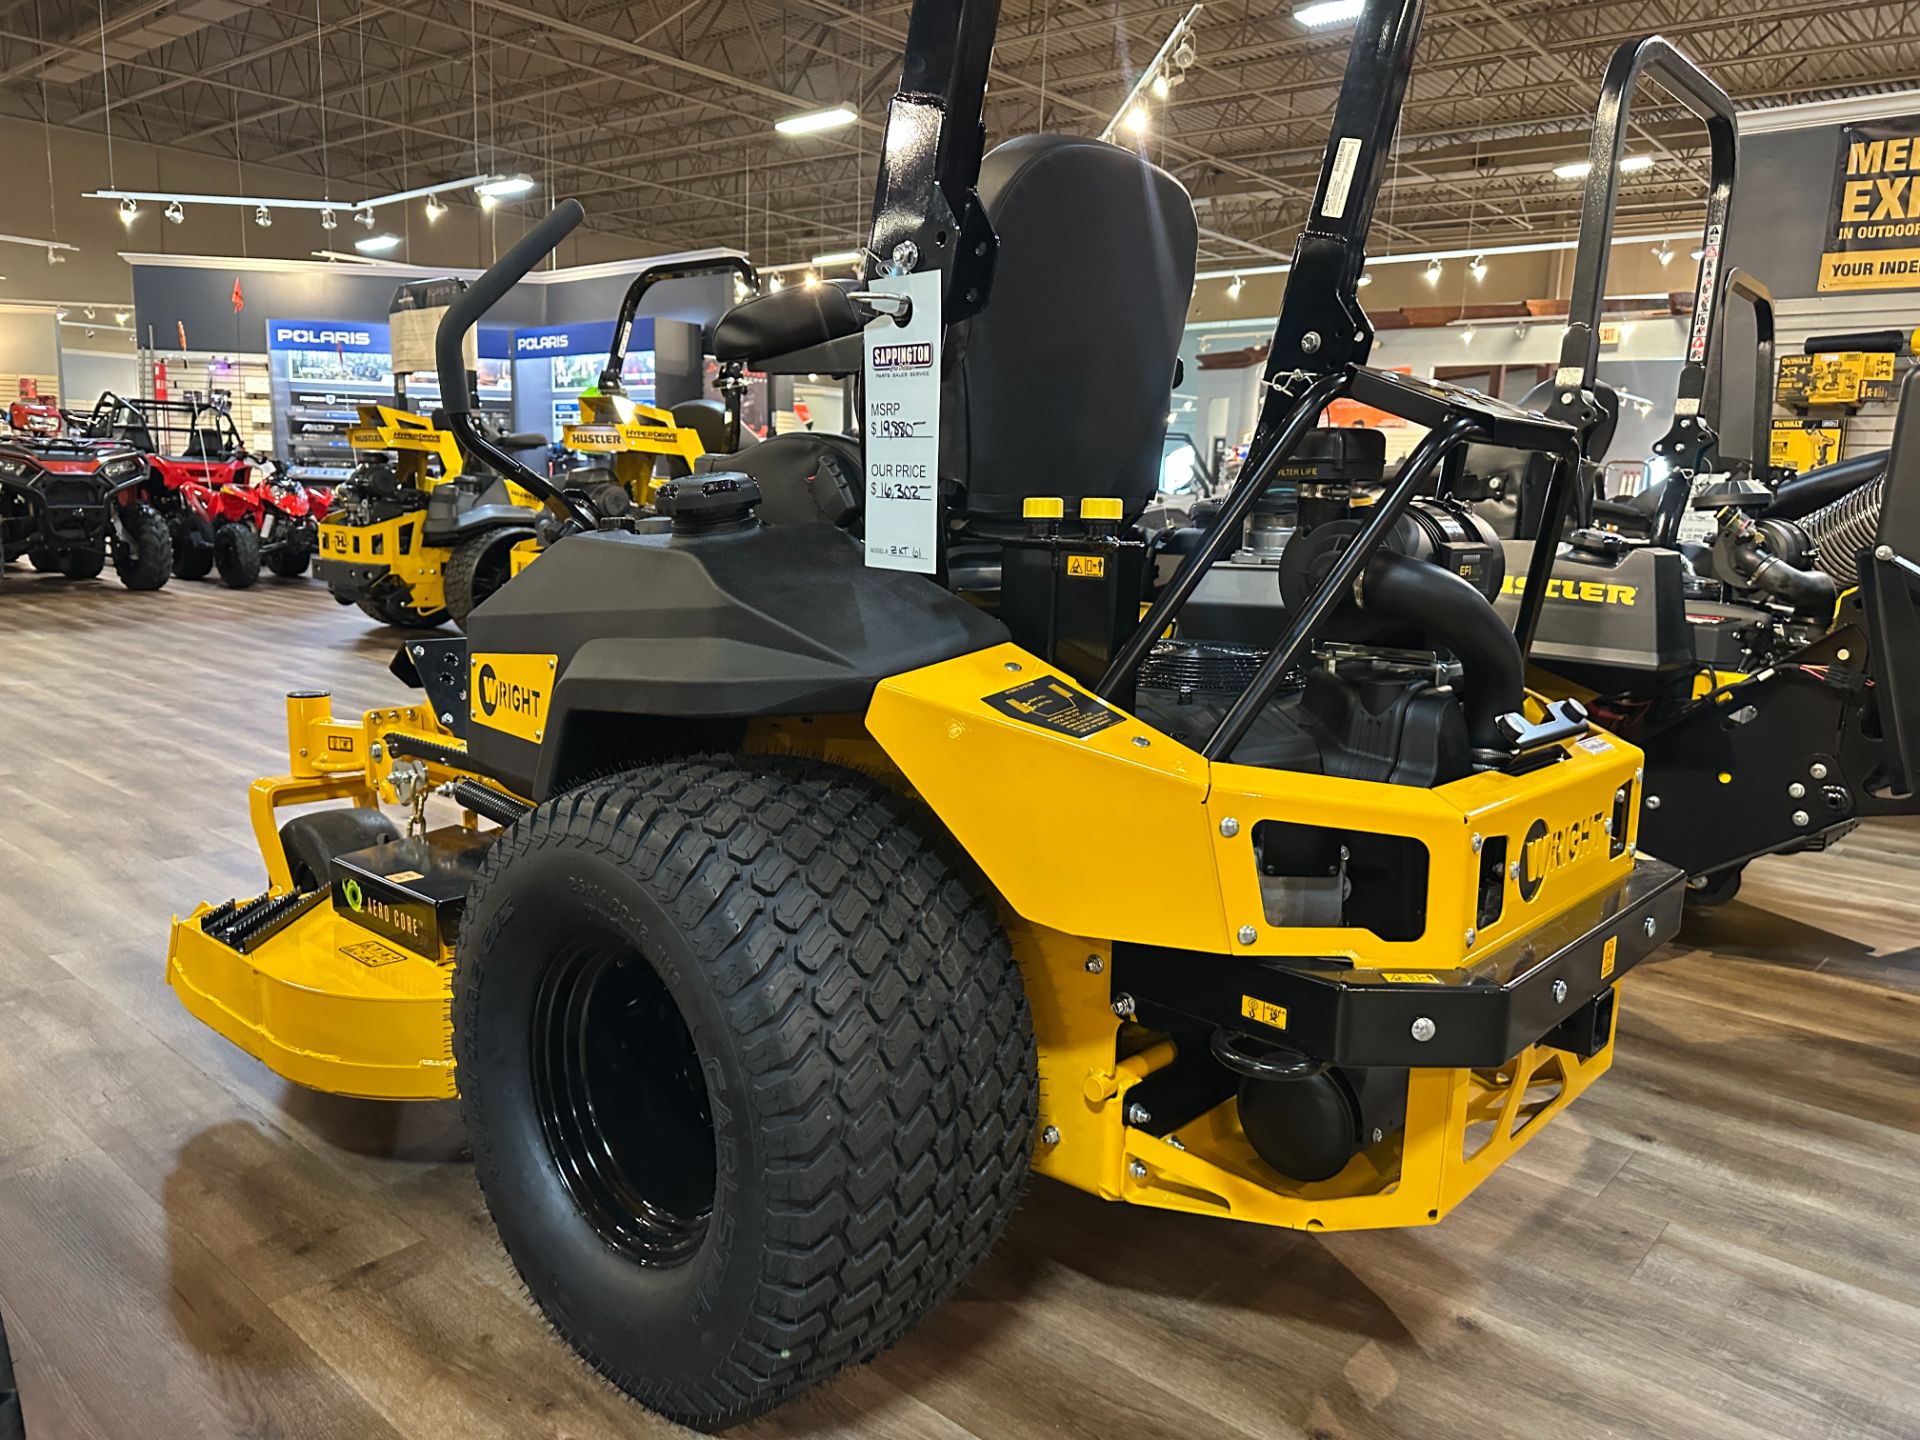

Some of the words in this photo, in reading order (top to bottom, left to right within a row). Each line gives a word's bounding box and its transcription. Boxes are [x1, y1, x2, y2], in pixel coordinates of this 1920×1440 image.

[1838, 227, 1853, 240] IN
[1832, 262, 1873, 277] YOUR
[1879, 259, 1920, 275] INDE
[277, 329, 370, 345] POLARIS
[517, 334, 569, 351] POLARIS
[874, 345, 930, 365] SAPPINGTON
[870, 402, 901, 417] MSRP
[572, 434, 621, 444] HUSTLER
[871, 463, 893, 477] OUR
[895, 464, 926, 478] PRICE
[1300, 467, 1318, 475] LIFE
[479, 664, 541, 718] WRIGHT
[1518, 818, 1604, 903] WRIGHT
[368, 896, 390, 922] AERO
[393, 909, 418, 936] CORE
